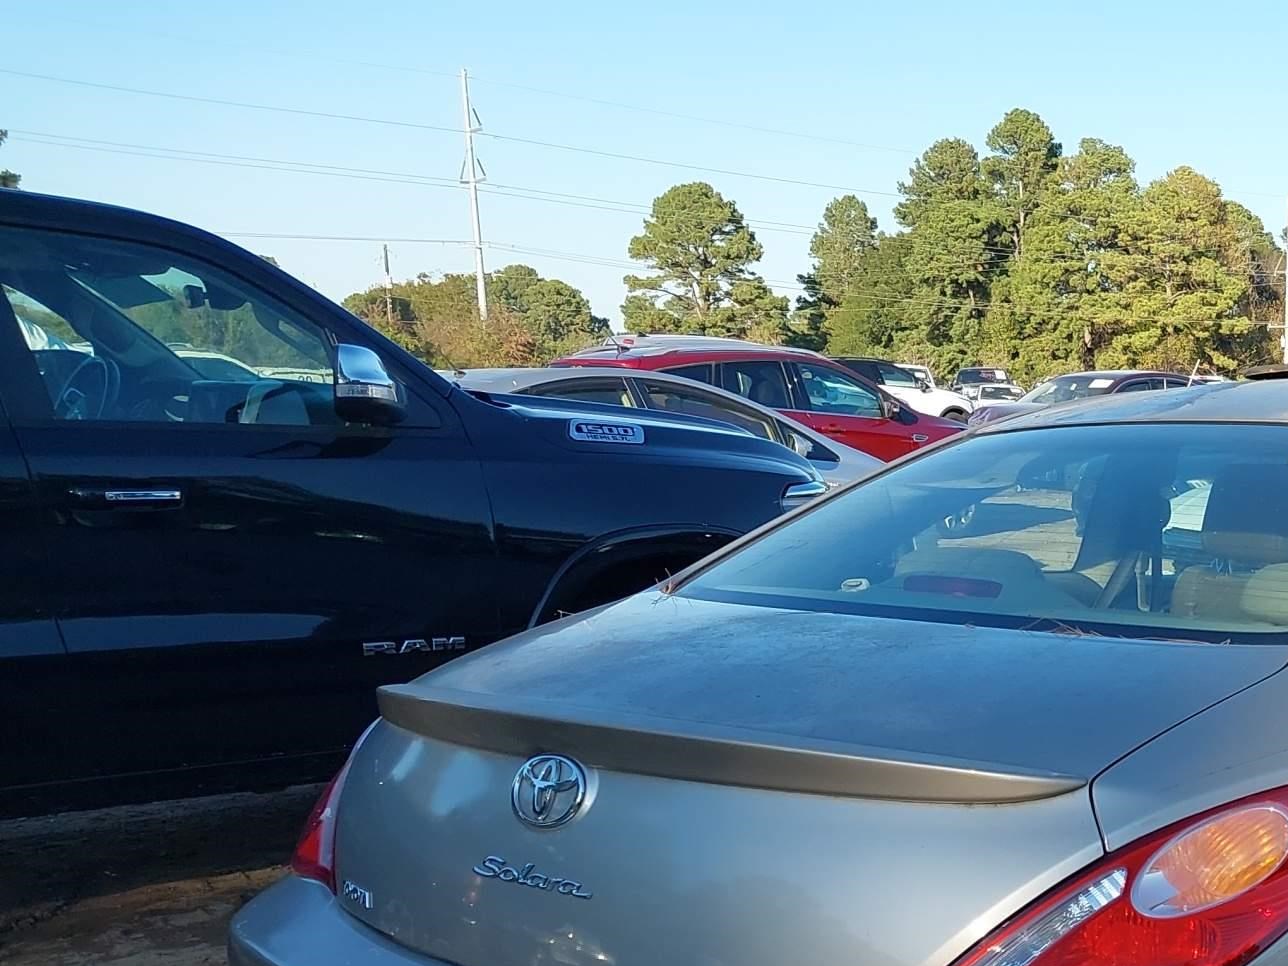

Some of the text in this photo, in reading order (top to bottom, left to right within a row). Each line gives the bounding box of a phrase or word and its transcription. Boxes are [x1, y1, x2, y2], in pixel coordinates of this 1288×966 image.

[578, 424, 634, 436] 1500
[362, 636, 465, 656] RAM
[472, 855, 592, 900] Solara
